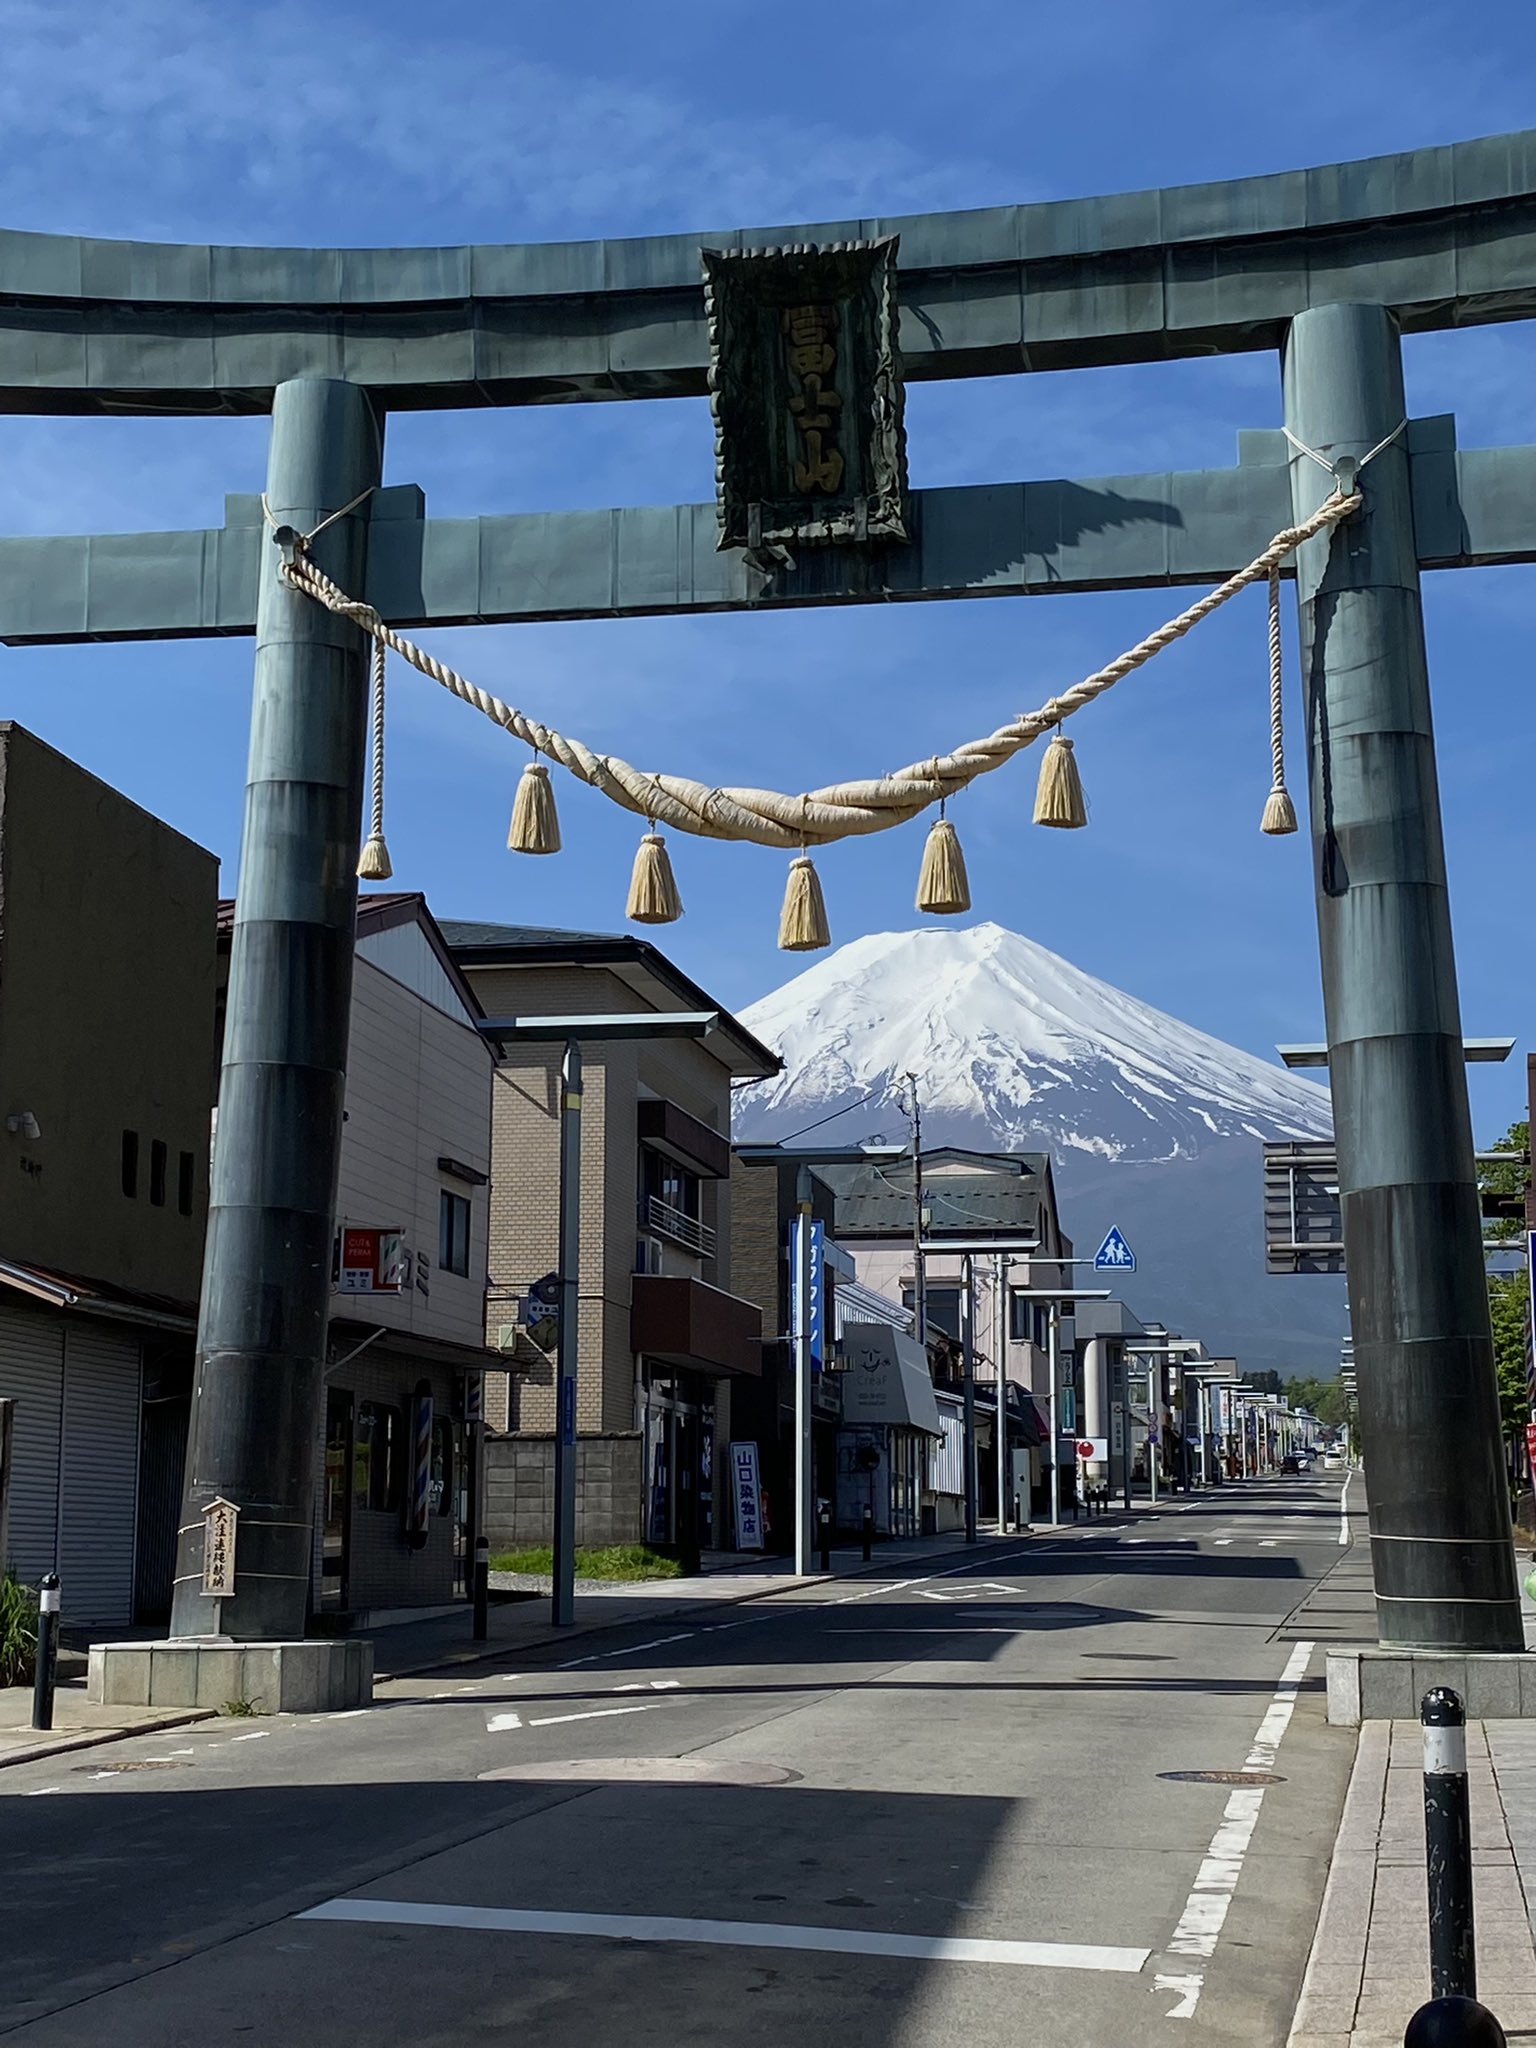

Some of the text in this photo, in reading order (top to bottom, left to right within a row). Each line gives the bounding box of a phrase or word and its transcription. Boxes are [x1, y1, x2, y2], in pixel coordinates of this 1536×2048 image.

[348, 1248, 372, 1257] PERM
[737, 1450, 756, 1534] 山口染物店
